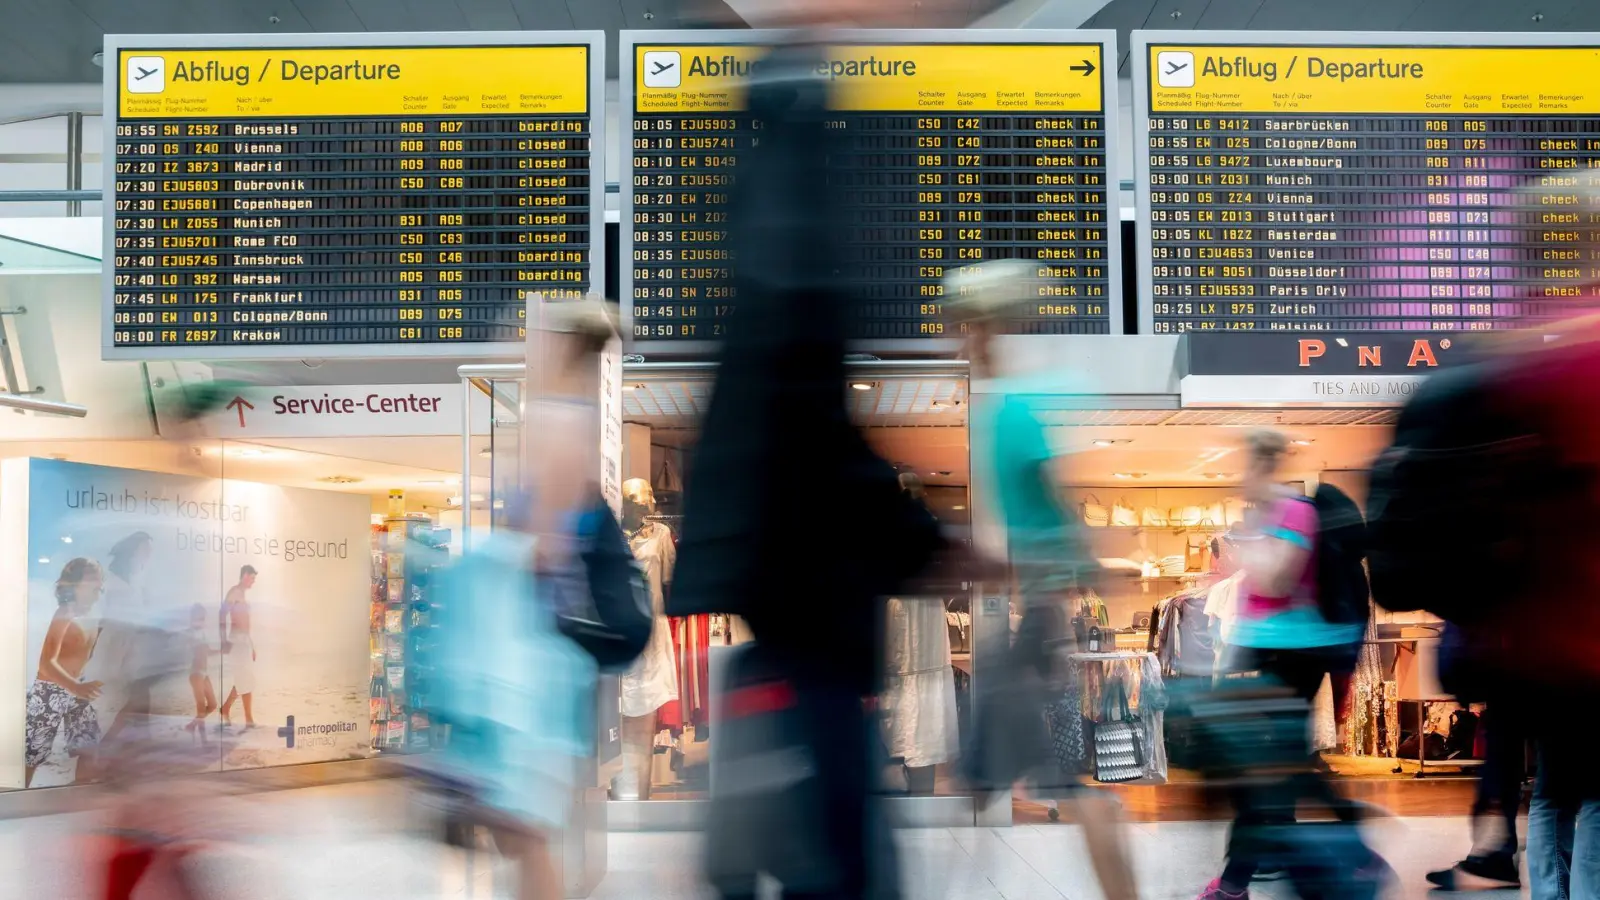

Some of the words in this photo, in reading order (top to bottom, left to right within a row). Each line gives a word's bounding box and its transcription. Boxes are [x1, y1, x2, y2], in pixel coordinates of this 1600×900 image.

[172, 60, 249, 86] Abflug
[281, 59, 401, 85] Departure
[814, 56, 916, 81] eparture
[1202, 56, 1277, 81] Abflug
[1308, 56, 1424, 82] Departure
[957, 91, 986, 99] Ausgang
[1035, 91, 1081, 99] Bemerkungen
[117, 125, 156, 136] 06:55
[164, 125, 179, 135] SN
[188, 124, 219, 135] 2592
[235, 124, 298, 135] Brussels
[400, 122, 424, 132] A06
[440, 122, 463, 132] A07
[519, 121, 582, 132] boarding
[634, 120, 673, 130] 08:05
[681, 119, 736, 129] EJU5903
[918, 119, 941, 129] C50
[957, 119, 979, 129] C42
[1036, 119, 1073, 129] check
[1084, 119, 1097, 129] in
[1150, 119, 1188, 129] 08:50
[1219, 120, 1249, 130] 9412
[1265, 119, 1349, 131] Saarbrücken
[1426, 121, 1447, 130] A06
[1464, 121, 1486, 131] A05
[116, 144, 156, 155] 07:00
[196, 143, 219, 154] 240
[235, 143, 282, 153] Vienna
[400, 141, 424, 151] A08
[440, 140, 463, 151] A06
[518, 140, 566, 150] closed
[634, 138, 673, 148] 08:10
[681, 138, 735, 148] EJU5741
[918, 137, 941, 147] C50
[958, 137, 980, 147] C40
[1036, 137, 1073, 147] check
[1084, 137, 1098, 147] in
[1150, 137, 1188, 148] 08:55
[1196, 138, 1211, 148] EW
[1227, 138, 1250, 148] 025
[1266, 138, 1357, 149] Cologne/Bonn
[1540, 139, 1577, 149] check
[1588, 139, 1600, 149] in
[634, 157, 673, 167] 08:10
[681, 157, 696, 167] EW
[704, 156, 736, 167] 9049
[1036, 155, 1074, 166] check
[1085, 155, 1098, 166] in
[1150, 156, 1188, 166] 08:55
[1220, 156, 1250, 166] 9472
[1266, 157, 1342, 168] Luxembourg
[1427, 157, 1448, 167] A06
[1465, 158, 1485, 167] A11
[1541, 158, 1577, 168] check
[1588, 158, 1600, 168] in
[116, 182, 155, 192] 07:30
[163, 180, 219, 191] EJU5603
[234, 179, 304, 191] Dubrovnik
[401, 178, 424, 188] C50
[519, 177, 566, 188] closed
[116, 201, 155, 211] 07:30
[234, 199, 313, 210] Copenhagen
[519, 195, 566, 206] closed
[116, 237, 155, 248] 07:35
[163, 237, 217, 247] EJU5701
[234, 236, 265, 247] Rome
[274, 236, 297, 246] FCO
[400, 234, 423, 244] C50
[439, 233, 463, 244] C63
[519, 233, 566, 243] closed
[115, 256, 154, 267] 07:40
[162, 255, 218, 266] EJU5745
[233, 255, 304, 265] Innsbruck
[399, 252, 422, 263] C50
[439, 252, 462, 263] C46
[518, 251, 582, 262] boarding
[1153, 248, 1191, 258] 09:10
[1199, 248, 1253, 258] EJU4653
[1269, 248, 1314, 258] Venice
[1429, 249, 1451, 259] C50
[1543, 249, 1580, 259] check
[115, 275, 154, 286] 07:40
[193, 274, 217, 284] 392
[233, 274, 281, 284] Warsaw
[400, 272, 423, 282] A05
[439, 271, 462, 282] A05
[518, 270, 582, 281] boarding
[1154, 285, 1192, 295] 09:15
[1200, 285, 1254, 296] EJU5533
[1270, 286, 1308, 296] Paris
[1316, 286, 1347, 297] Orly
[1431, 285, 1453, 295] C50
[1470, 285, 1491, 295] C40
[1545, 286, 1582, 296] check
[115, 331, 154, 342] 08:00
[162, 330, 177, 341] FR
[185, 330, 217, 341] 2697
[233, 330, 280, 340] Krakow
[400, 328, 421, 338] C61
[1313, 381, 1344, 395] TIES
[1349, 382, 1380, 395] AND
[273, 393, 441, 415] Service-Center
[66, 486, 137, 513] urlaub
[144, 492, 170, 515] ist
[176, 494, 250, 522] kostbar
[176, 528, 248, 555] bleiben
[254, 534, 278, 556] sie
[284, 538, 348, 562] gesund
[298, 720, 357, 736] metropolitan
[297, 737, 336, 749] pharmacy
